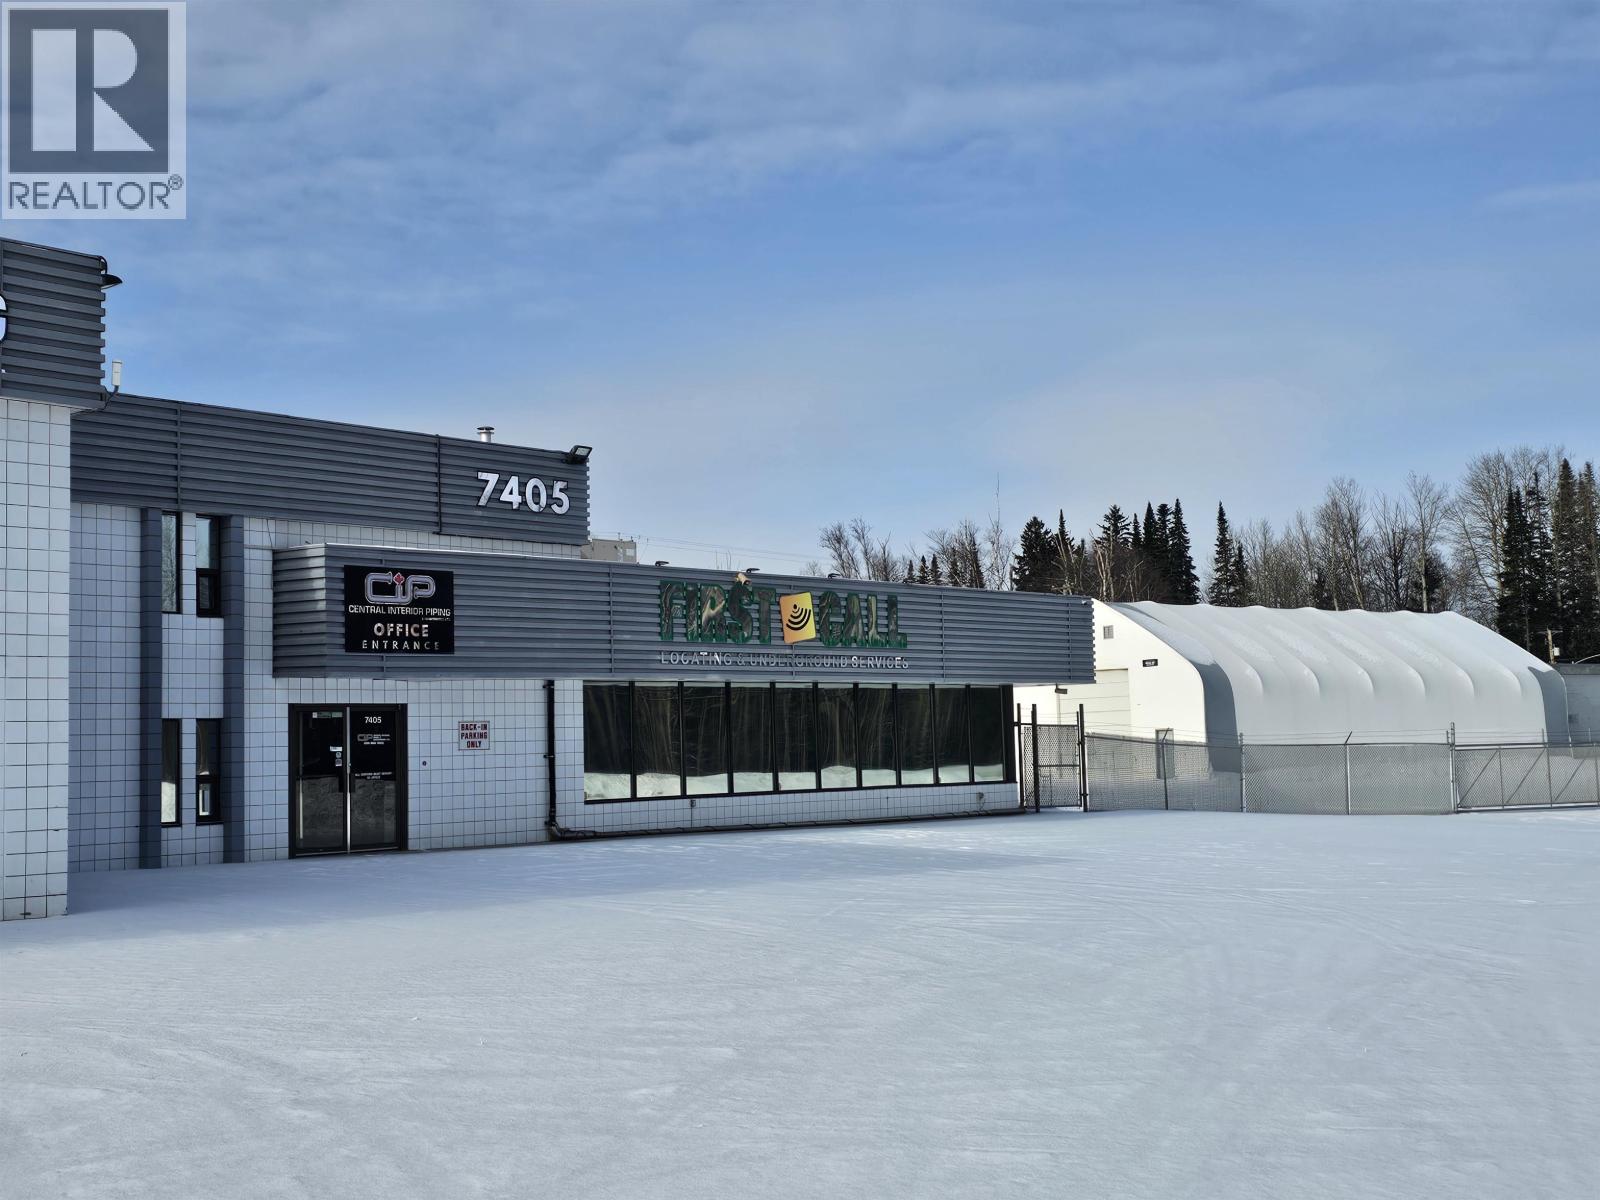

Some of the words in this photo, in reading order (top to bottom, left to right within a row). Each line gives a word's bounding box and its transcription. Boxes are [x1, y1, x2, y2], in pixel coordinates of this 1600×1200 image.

[477, 471, 570, 515] 7405
[348, 604, 386, 615] CENTRAL
[387, 606, 424, 615] INTERIOR
[425, 608, 451, 617] PIPING
[659, 580, 777, 645] FIRST
[819, 591, 908, 648] CALL
[373, 622, 429, 637] OFFICE
[362, 640, 440, 650] ENTRANCE
[661, 651, 732, 665] LOCATING
[737, 653, 746, 666] &
[750, 653, 848, 668] UNDERGROUND
[851, 656, 909, 669] SERVICES
[364, 716, 382, 724] 7405
[460, 723, 488, 731] BACK-IN
[460, 731, 488, 740] PARKING
[466, 740, 482, 749] ONLY
